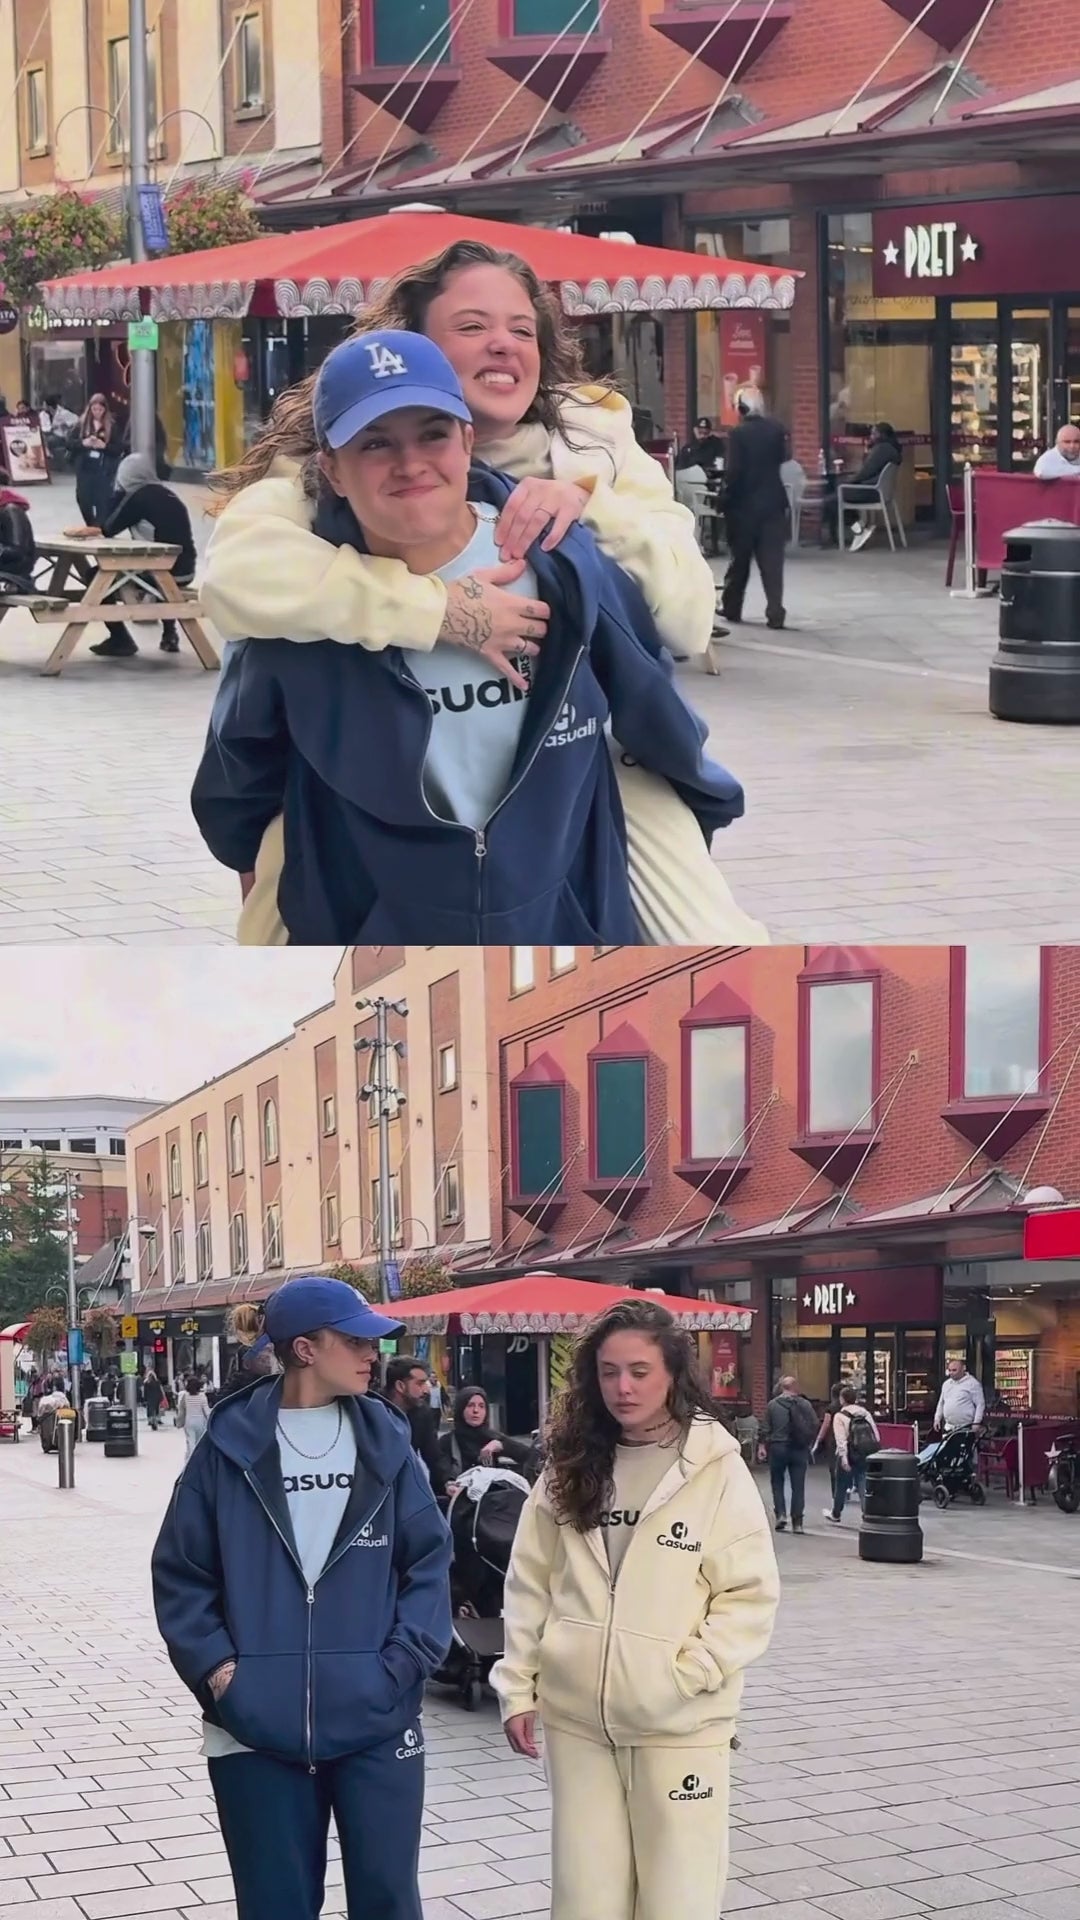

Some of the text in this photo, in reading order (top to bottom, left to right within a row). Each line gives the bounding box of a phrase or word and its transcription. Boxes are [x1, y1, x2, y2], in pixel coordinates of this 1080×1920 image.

[904, 222, 957, 278] PRET
[364, 342, 408, 378] LA
[814, 1282, 844, 1314] PRET
[507, 1336, 529, 1353] JD
